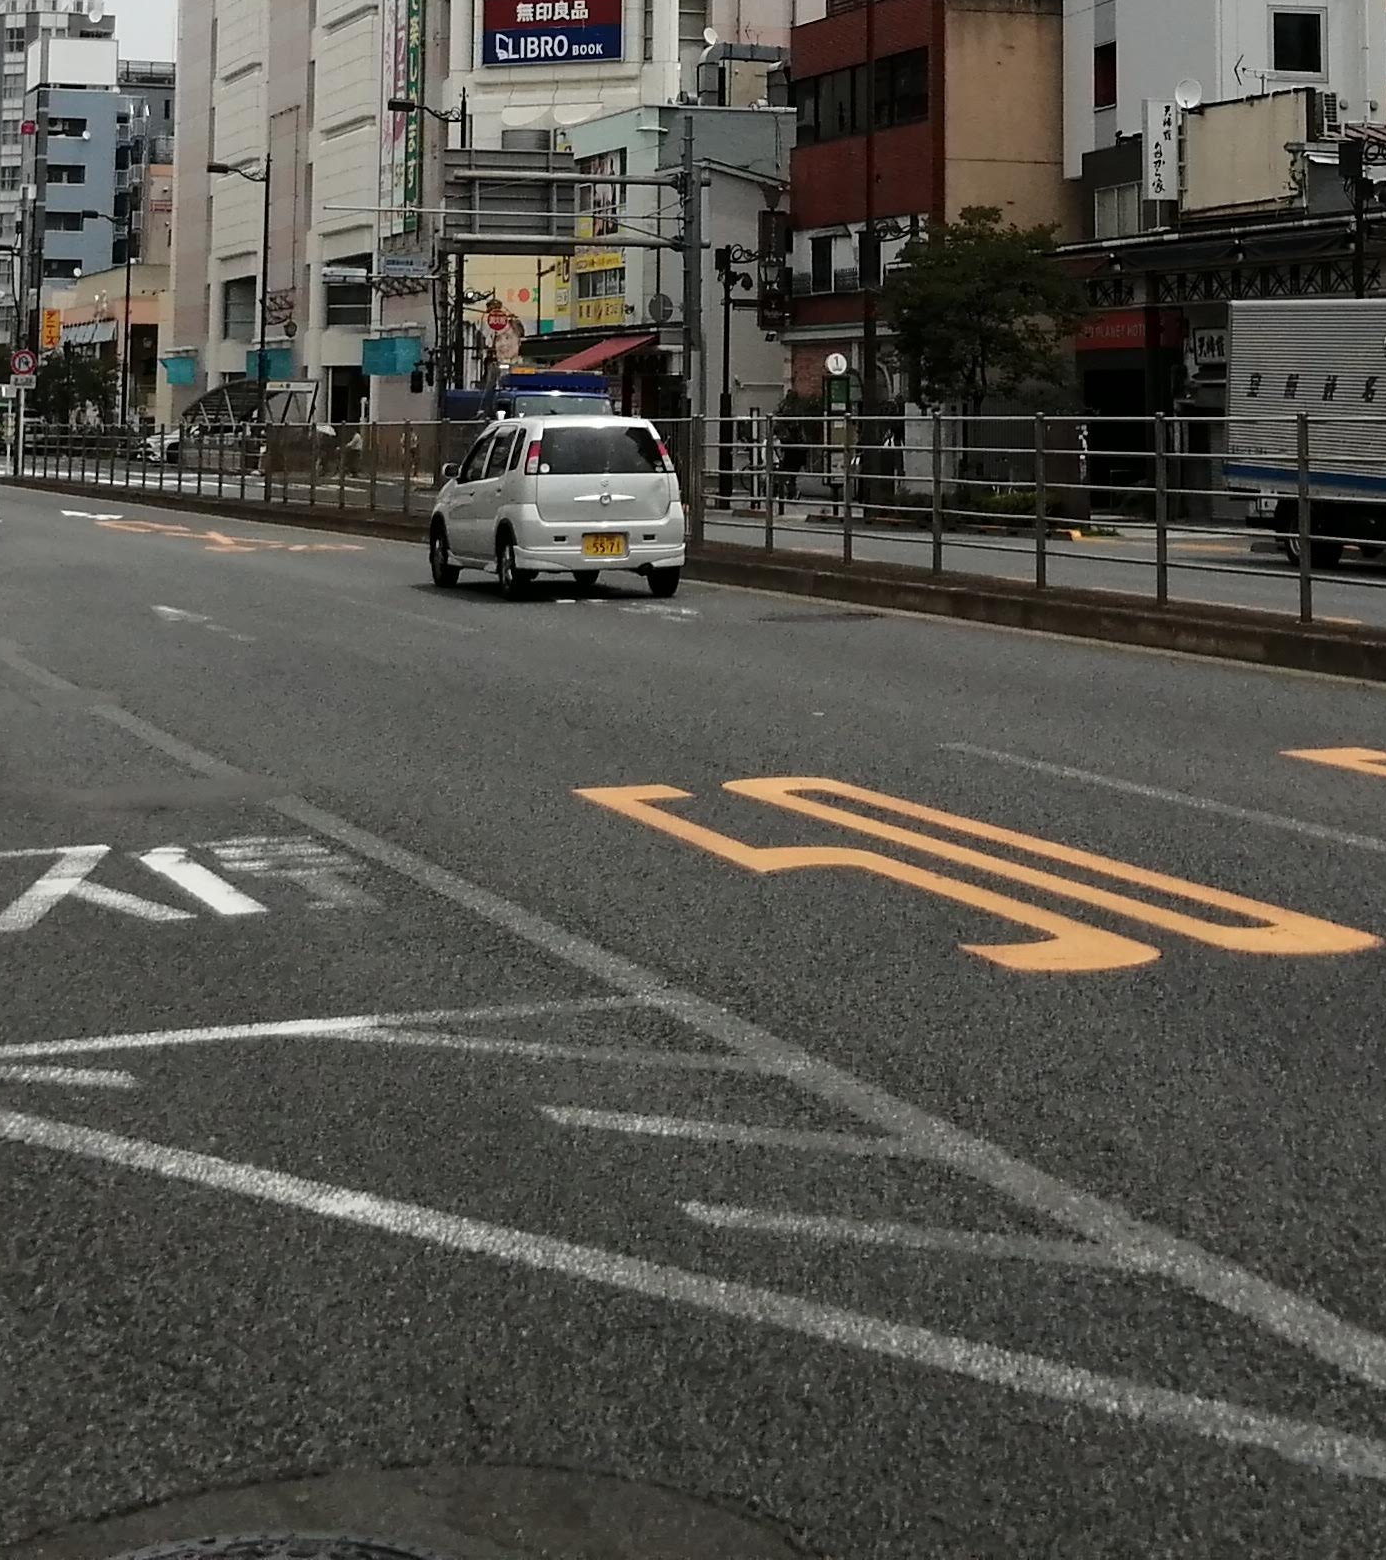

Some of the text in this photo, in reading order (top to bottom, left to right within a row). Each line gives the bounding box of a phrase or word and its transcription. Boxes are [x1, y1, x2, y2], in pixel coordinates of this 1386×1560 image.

[516, 0, 588, 22] 無印良品
[508, 35, 603, 58] LIBRO BOOK
